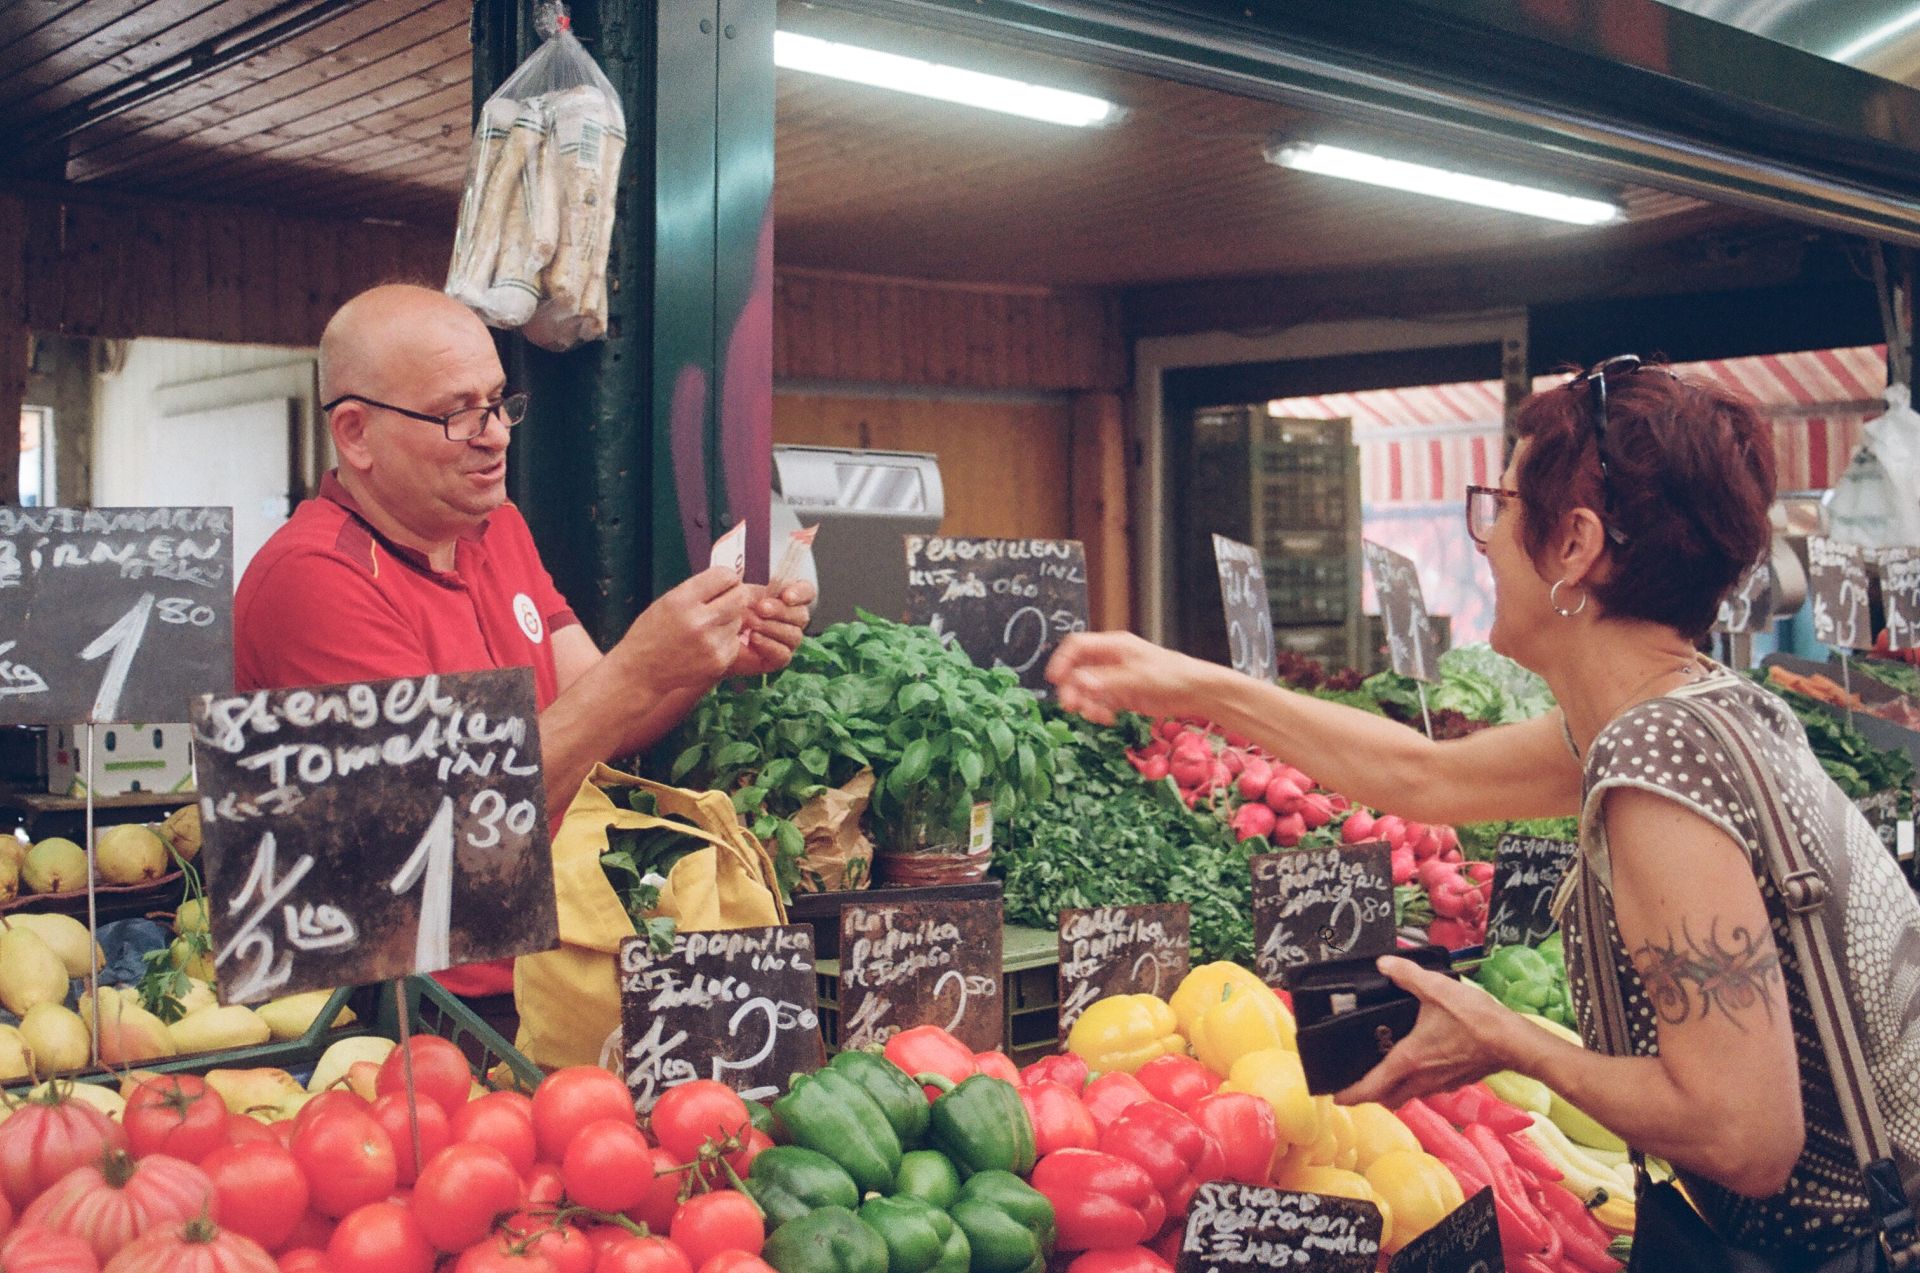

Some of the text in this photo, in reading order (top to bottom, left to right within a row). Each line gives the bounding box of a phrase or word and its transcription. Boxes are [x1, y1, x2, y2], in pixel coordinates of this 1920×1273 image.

[79, 591, 215, 717] 1 80
[438, 748, 539, 782] INL
[389, 789, 537, 976] 1 30
[1362, 896, 1391, 923] 80
[775, 1000, 819, 1030] 50
